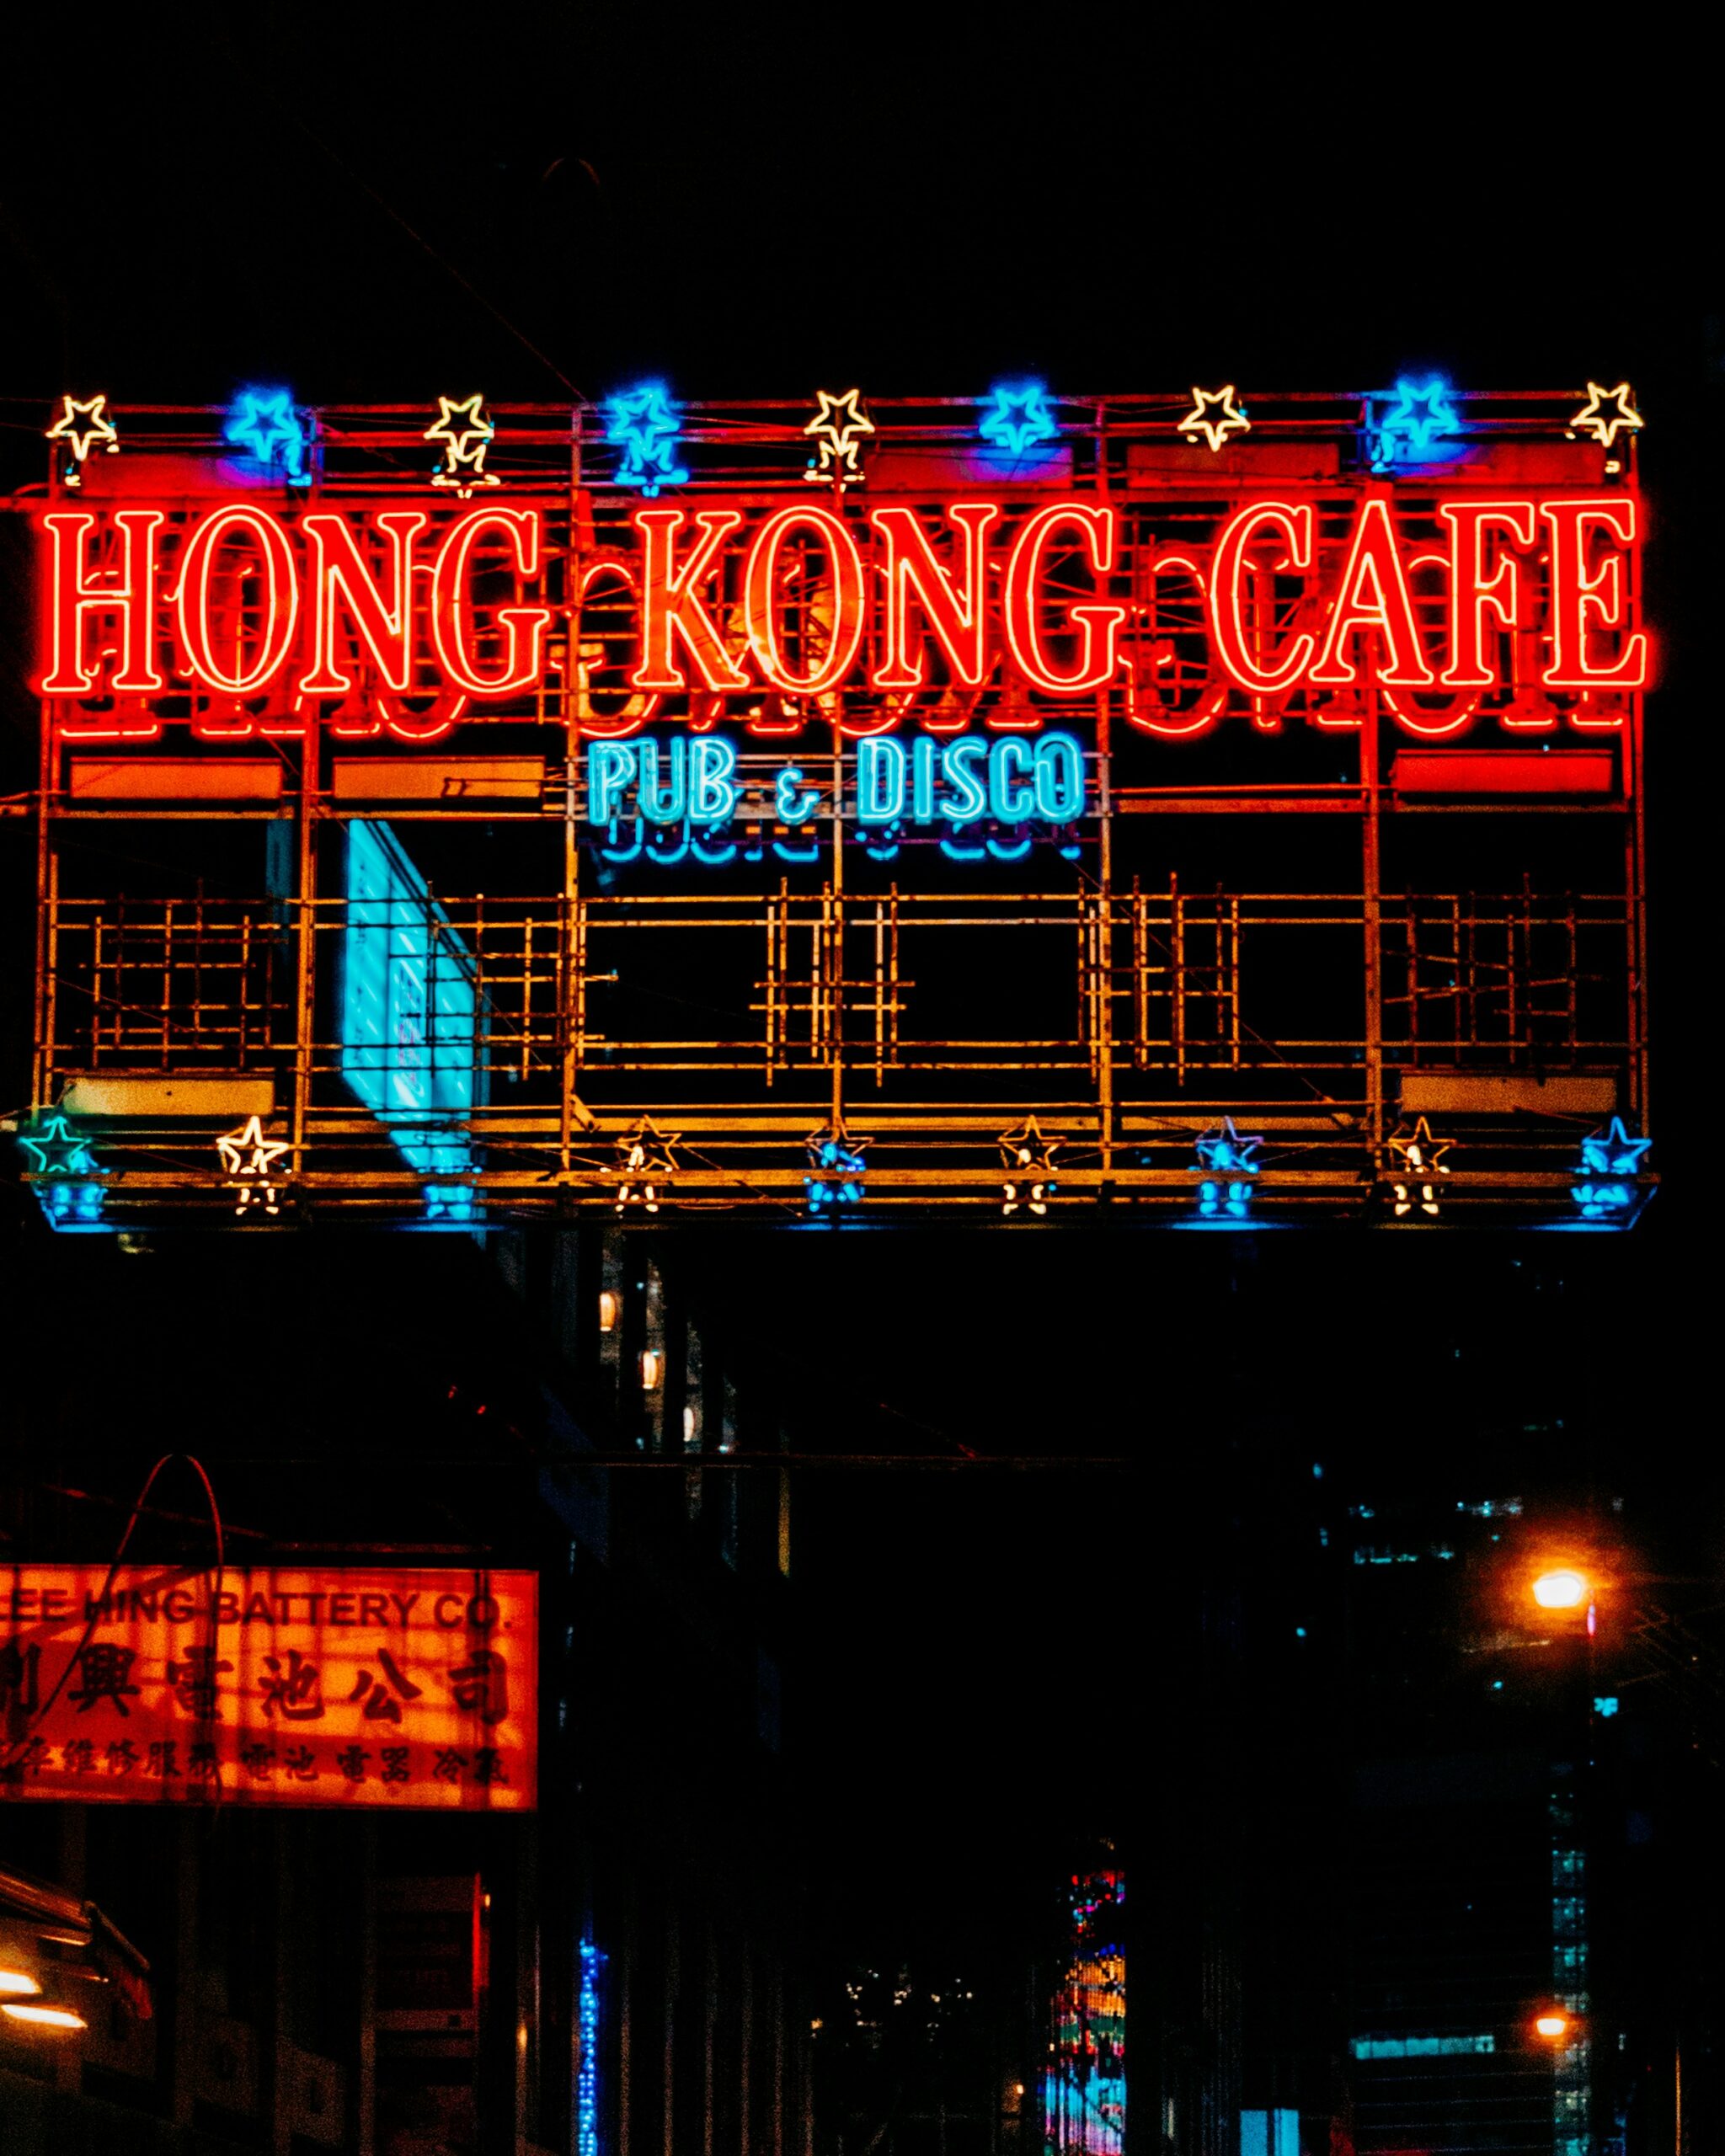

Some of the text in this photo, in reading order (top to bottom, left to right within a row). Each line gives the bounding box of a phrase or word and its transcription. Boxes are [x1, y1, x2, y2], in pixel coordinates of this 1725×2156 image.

[42, 499, 1647, 694] HONG KONG CAFE
[589, 732, 1085, 825] PUB & DISCO
[84, 1589, 195, 1624] HING
[211, 1591, 419, 1627] BATTERY
[434, 1593, 511, 1629] CO.
